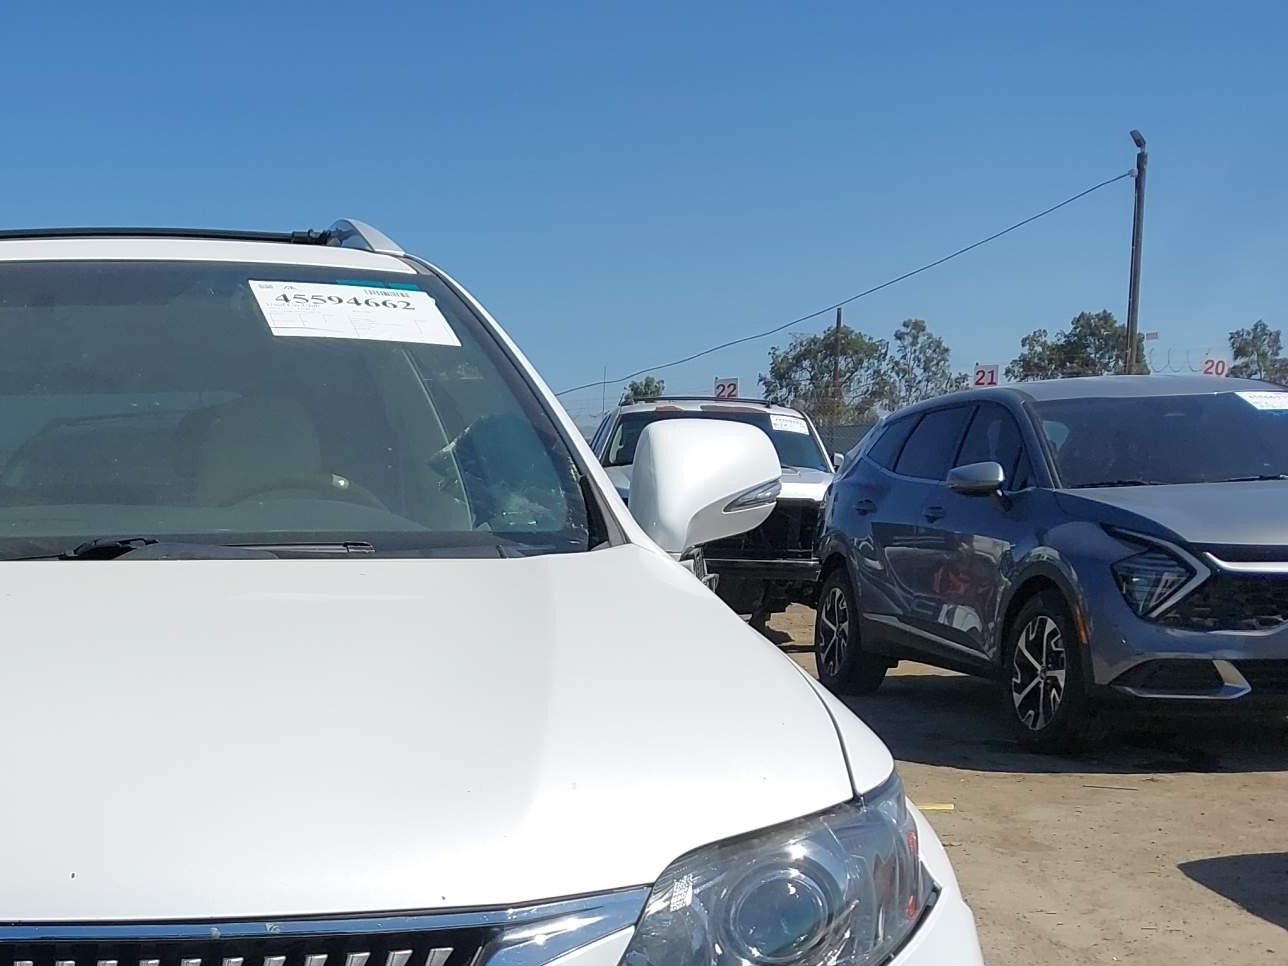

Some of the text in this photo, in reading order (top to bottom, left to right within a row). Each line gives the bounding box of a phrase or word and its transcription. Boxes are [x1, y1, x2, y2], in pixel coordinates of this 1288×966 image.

[275, 293, 416, 311] 45594662
[1203, 359, 1226, 376] 20
[975, 369, 997, 386] 21
[716, 383, 737, 399] 22
